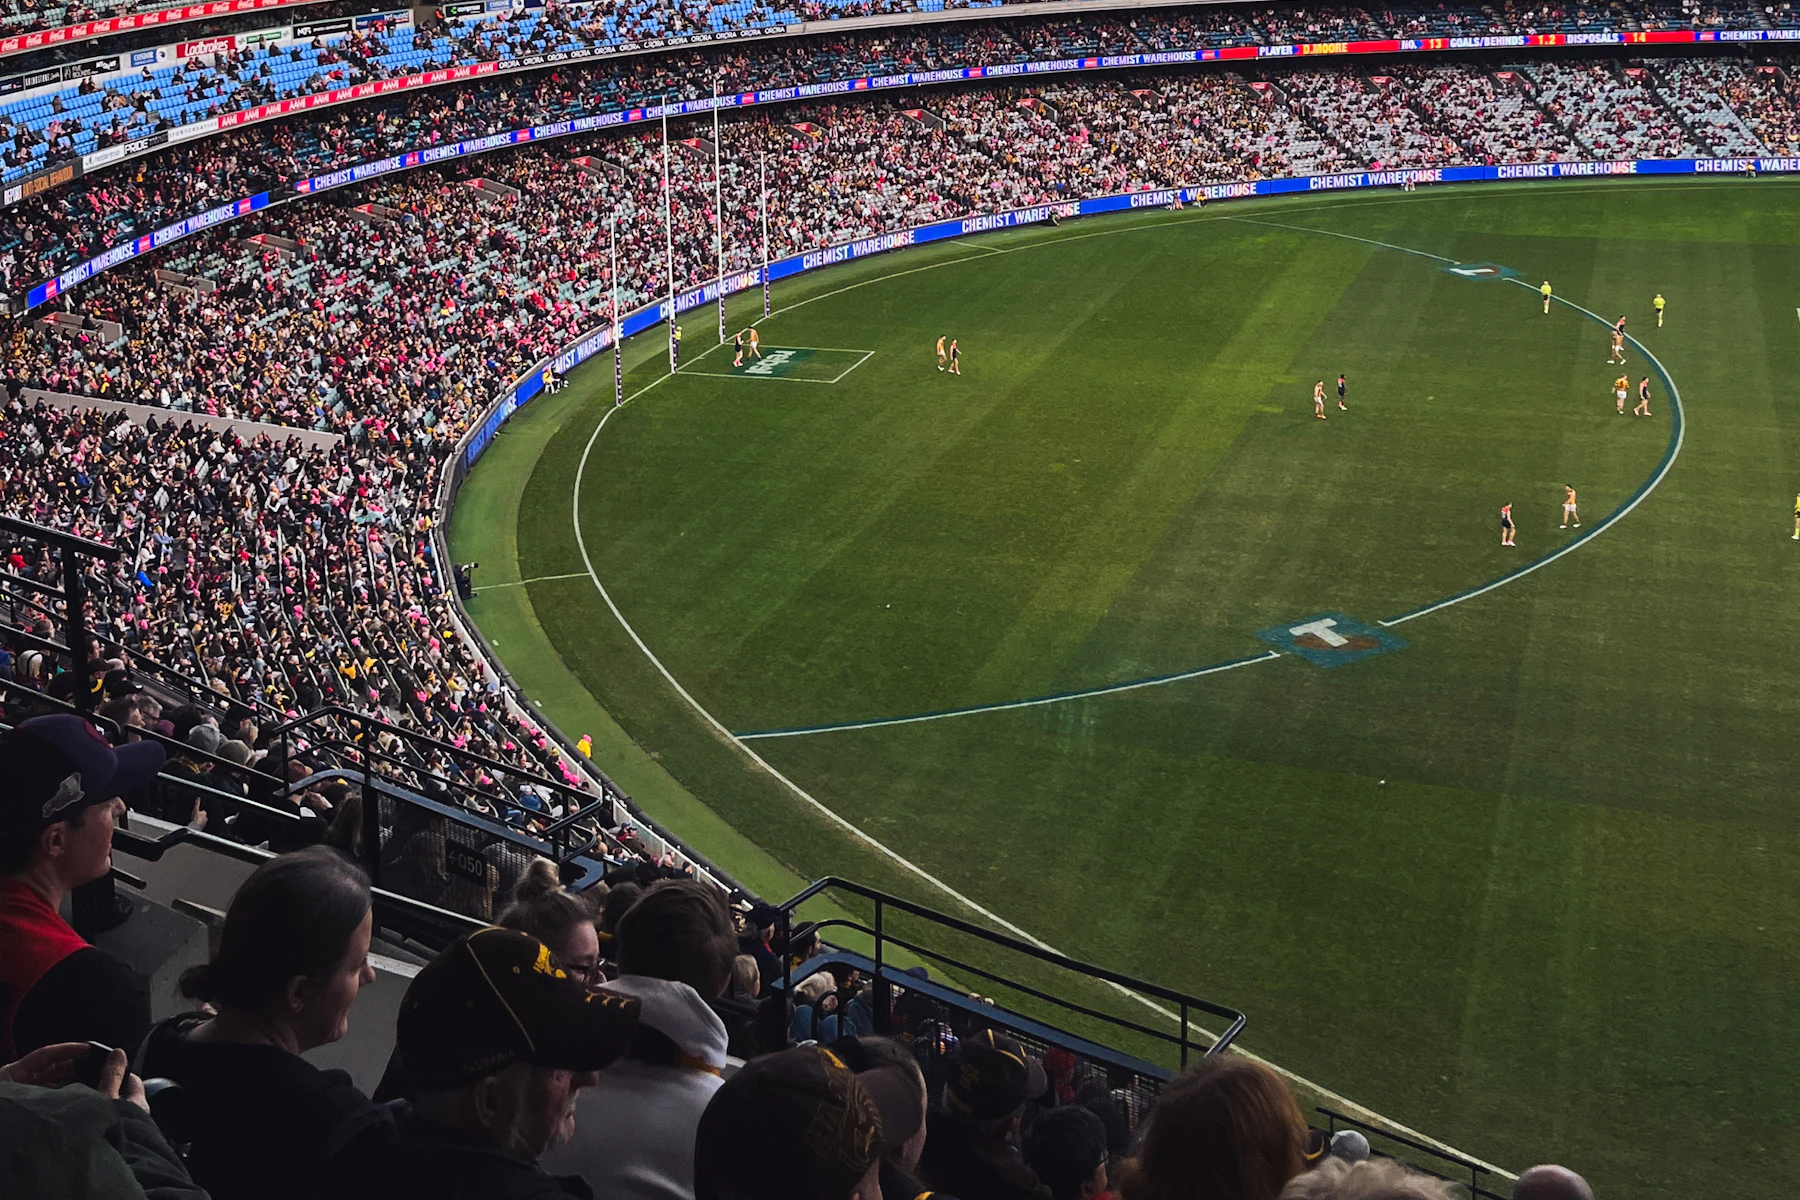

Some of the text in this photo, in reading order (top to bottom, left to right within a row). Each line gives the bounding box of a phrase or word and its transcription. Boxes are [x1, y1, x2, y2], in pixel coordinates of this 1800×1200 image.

[1260, 32, 1646, 56] PLAYER D.MOORE NO. 13 GOALS/BEHINDS 1.2 DISPOSALS 14
[1720, 30, 1764, 41] CHEMIST
[185, 40, 228, 57] Ladbrokes
[987, 59, 1079, 76] CHEMIST WAREHOUSE
[1102, 51, 1196, 67] CHEMIST WAREHOUSE
[873, 69, 963, 88] CHEMIST WAREHOUSE
[759, 81, 849, 101] CHEMIST WAREHOUSE
[534, 112, 623, 137] CHEMIST WAREHOUSE
[125, 139, 148, 154] PRIDE
[424, 132, 511, 161] CHEMIST WAREHOUSE
[315, 156, 400, 189] CHEMIST WAREHOUSE
[1498, 161, 1637, 179] CHEMIST WAREHOUSE
[1310, 174, 1364, 190] CHEMIST
[154, 223, 186, 245] CHEMIST
[187, 203, 234, 233] WAREHOUSE
[962, 212, 1011, 233] CHEMIST
[803, 230, 915, 269] CHEMIST WAREHOUSE
[60, 262, 90, 290] CHEMIST
[92, 241, 135, 275] WAREHOUSE
[745, 350, 796, 374] rebel
